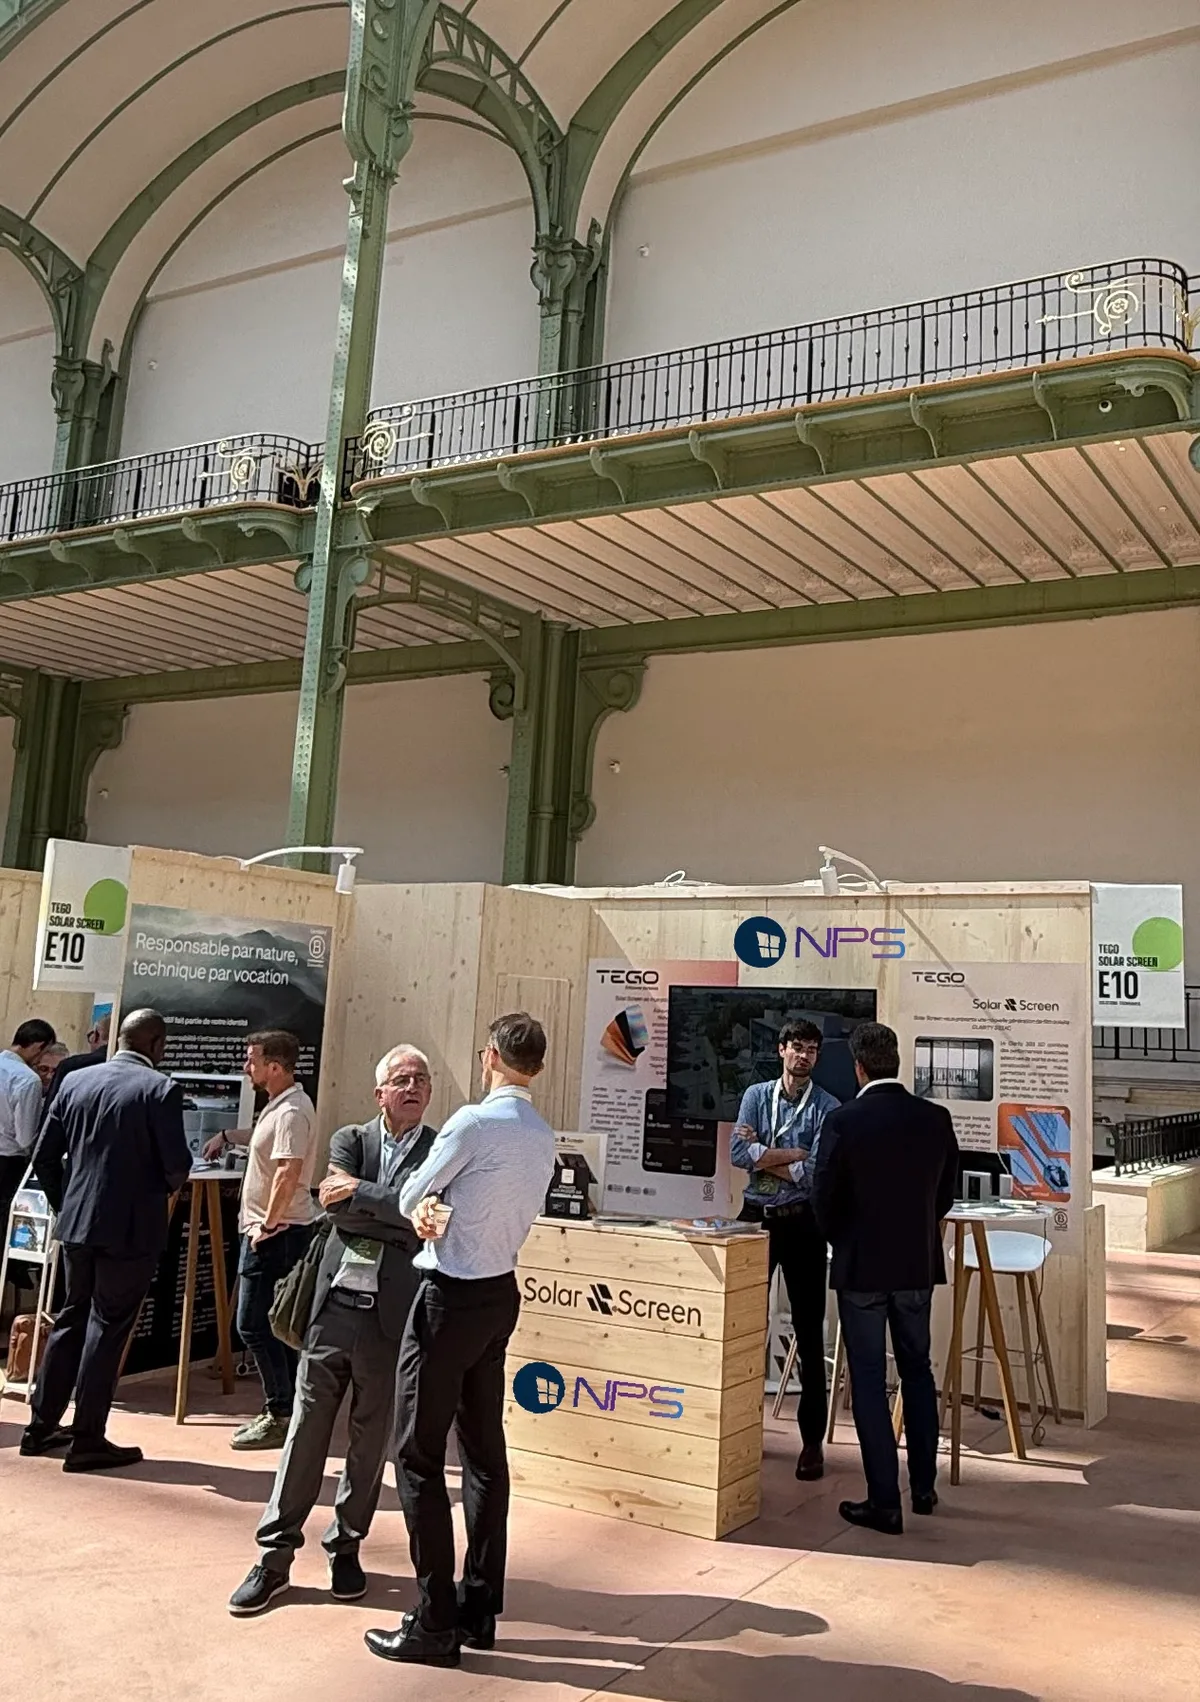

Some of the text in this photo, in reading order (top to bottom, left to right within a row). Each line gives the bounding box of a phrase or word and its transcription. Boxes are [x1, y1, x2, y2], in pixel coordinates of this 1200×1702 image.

[51, 902, 72, 914] TEGO
[49, 915, 105, 931] SOLAR SCREEN
[45, 931, 85, 963] E10
[135, 932, 230, 957] Responsable
[231, 945, 254, 960] par
[255, 947, 299, 966] nature,
[1098, 956, 1158, 968] SOLAR SCREEN
[132, 959, 289, 985] technique par vocation
[596, 969, 660, 985] TEGO
[911, 971, 966, 984] TEGO
[1098, 970, 1139, 1000] E10
[972, 998, 1060, 1012] Solar Screen
[523, 1277, 702, 1327] Solar Screen
